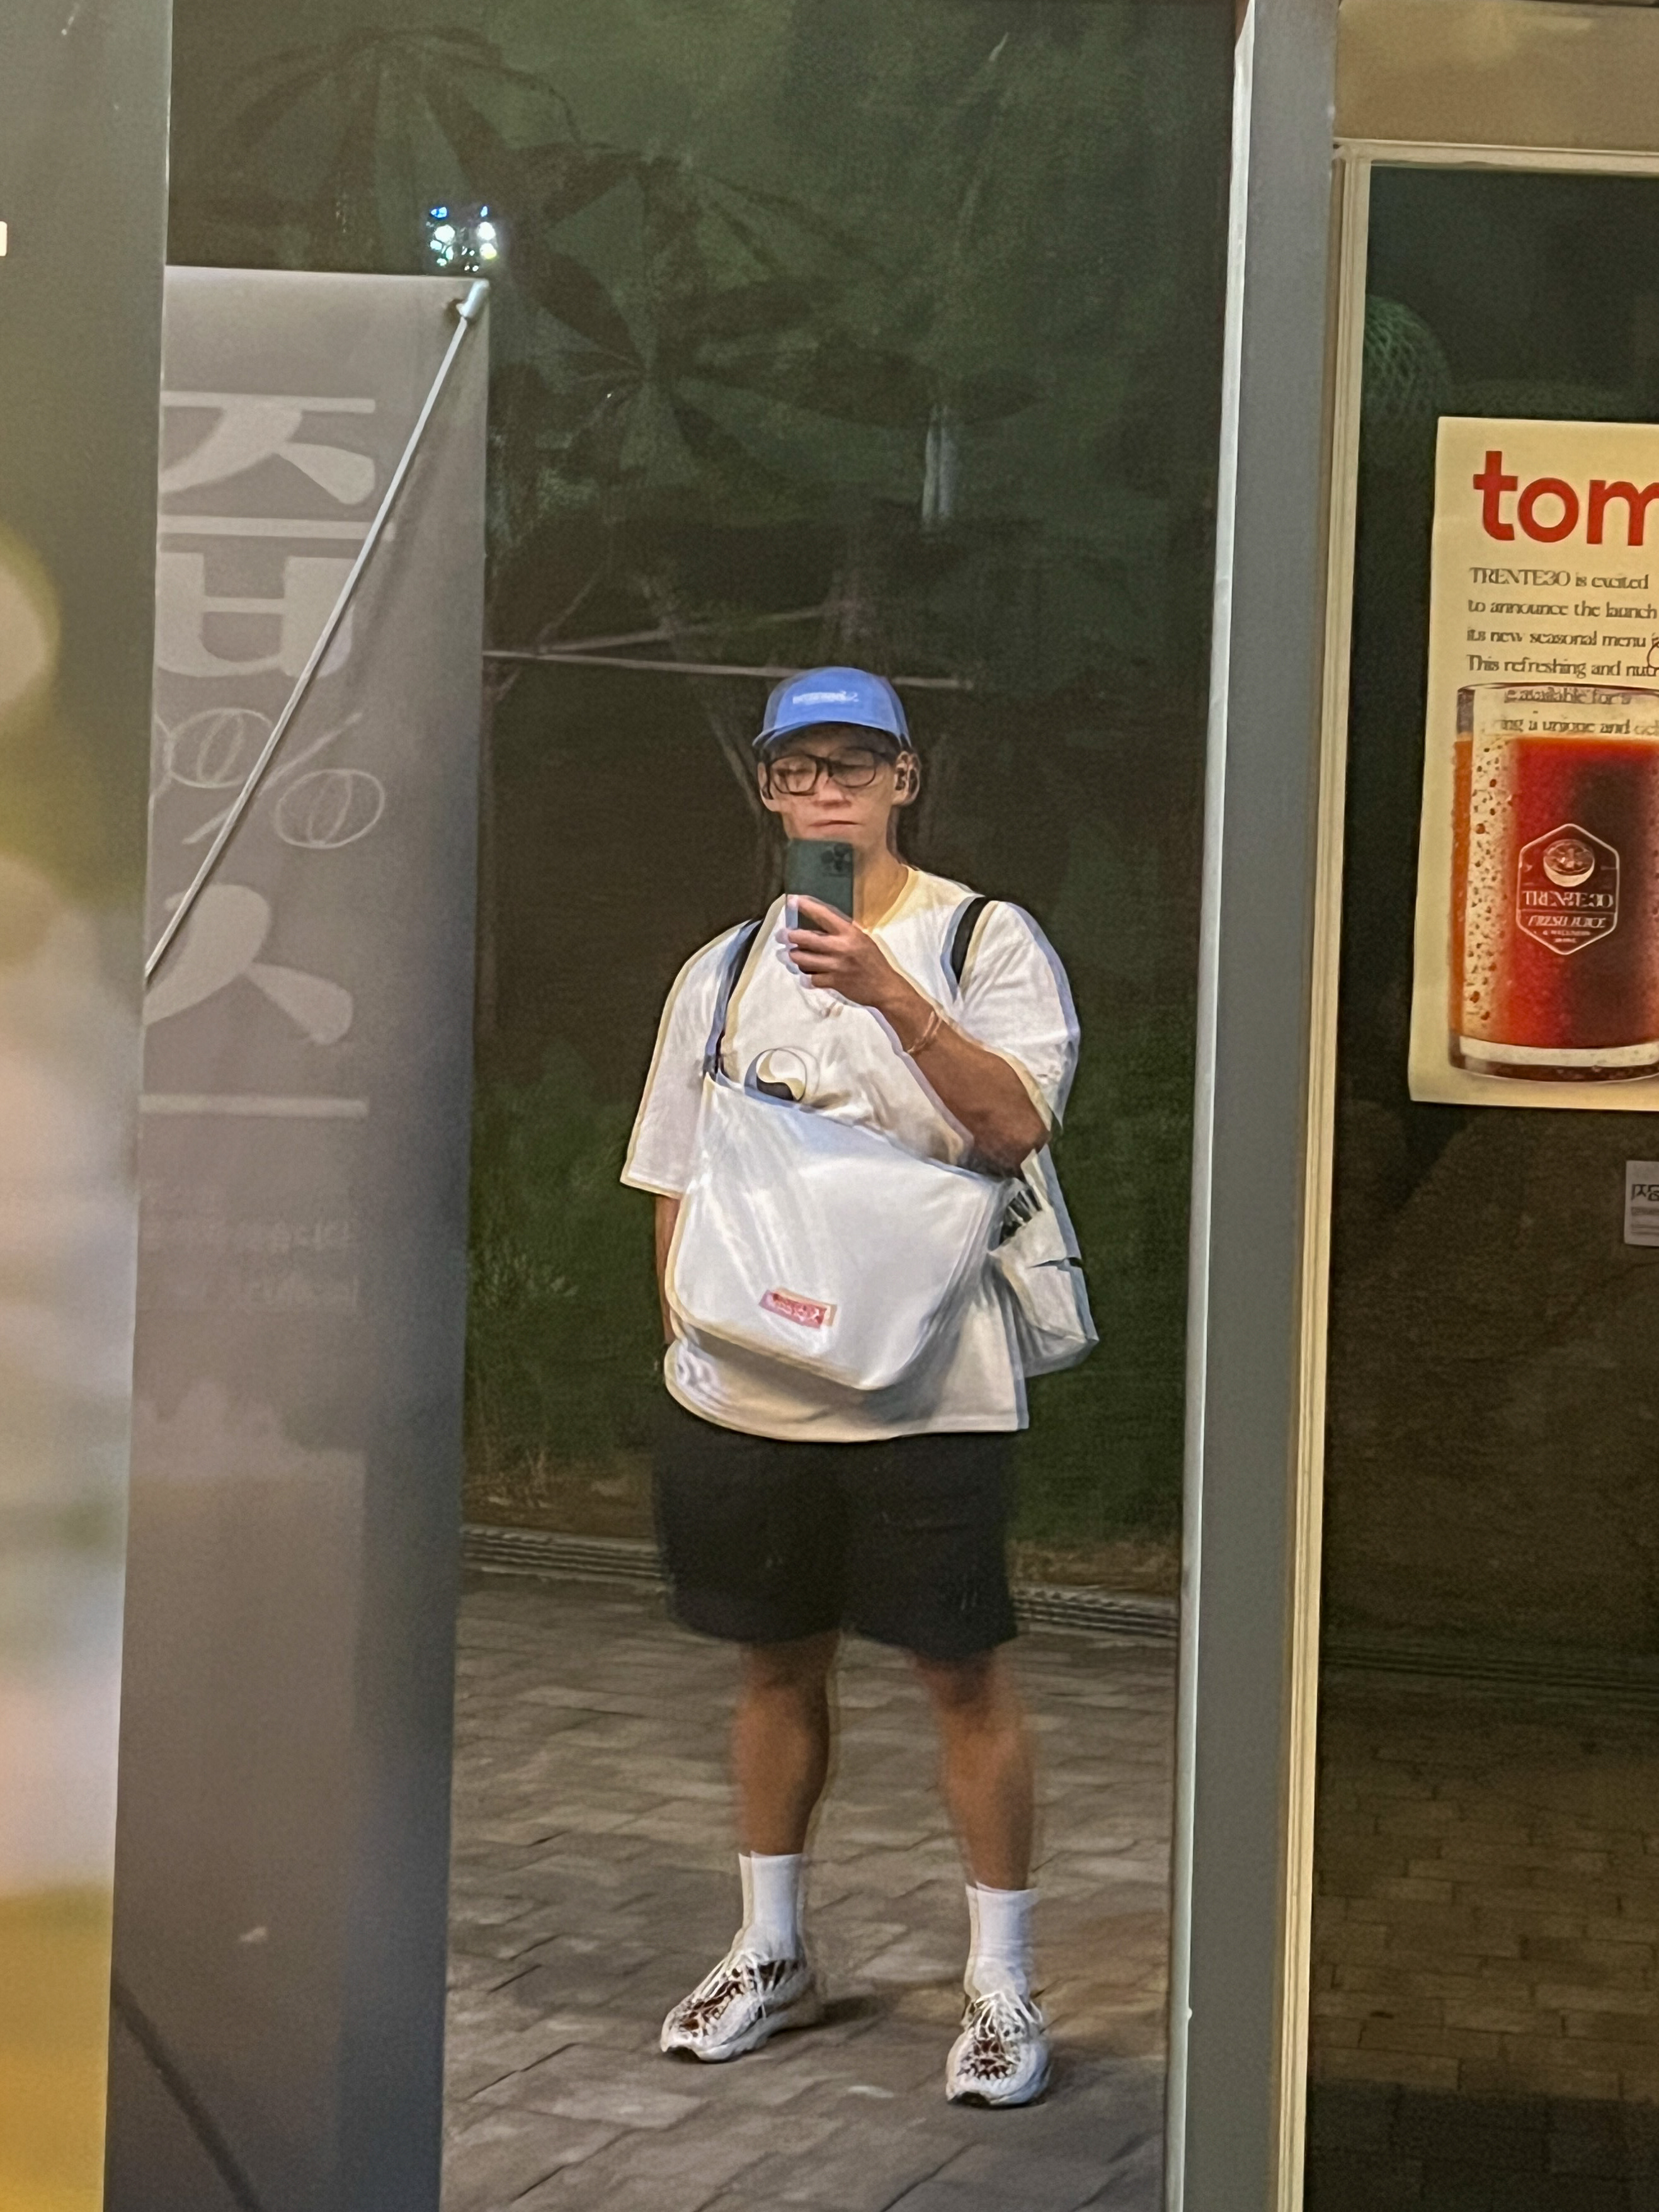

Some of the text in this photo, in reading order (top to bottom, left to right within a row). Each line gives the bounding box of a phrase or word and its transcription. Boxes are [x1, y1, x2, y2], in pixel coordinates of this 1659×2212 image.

[1575, 572, 1587, 587] is
[1591, 574, 1650, 590] excited
[1468, 599, 1658, 620] to announce the launch
[1466, 627, 1486, 642] its
[1490, 630, 1523, 642] new
[1529, 630, 1598, 646] seasonal
[1602, 635, 1646, 647] menu
[1466, 654, 1500, 671] This
[1504, 656, 1587, 679] refreshing
[1590, 660, 1622, 676] and
[1599, 719, 1631, 734] and
